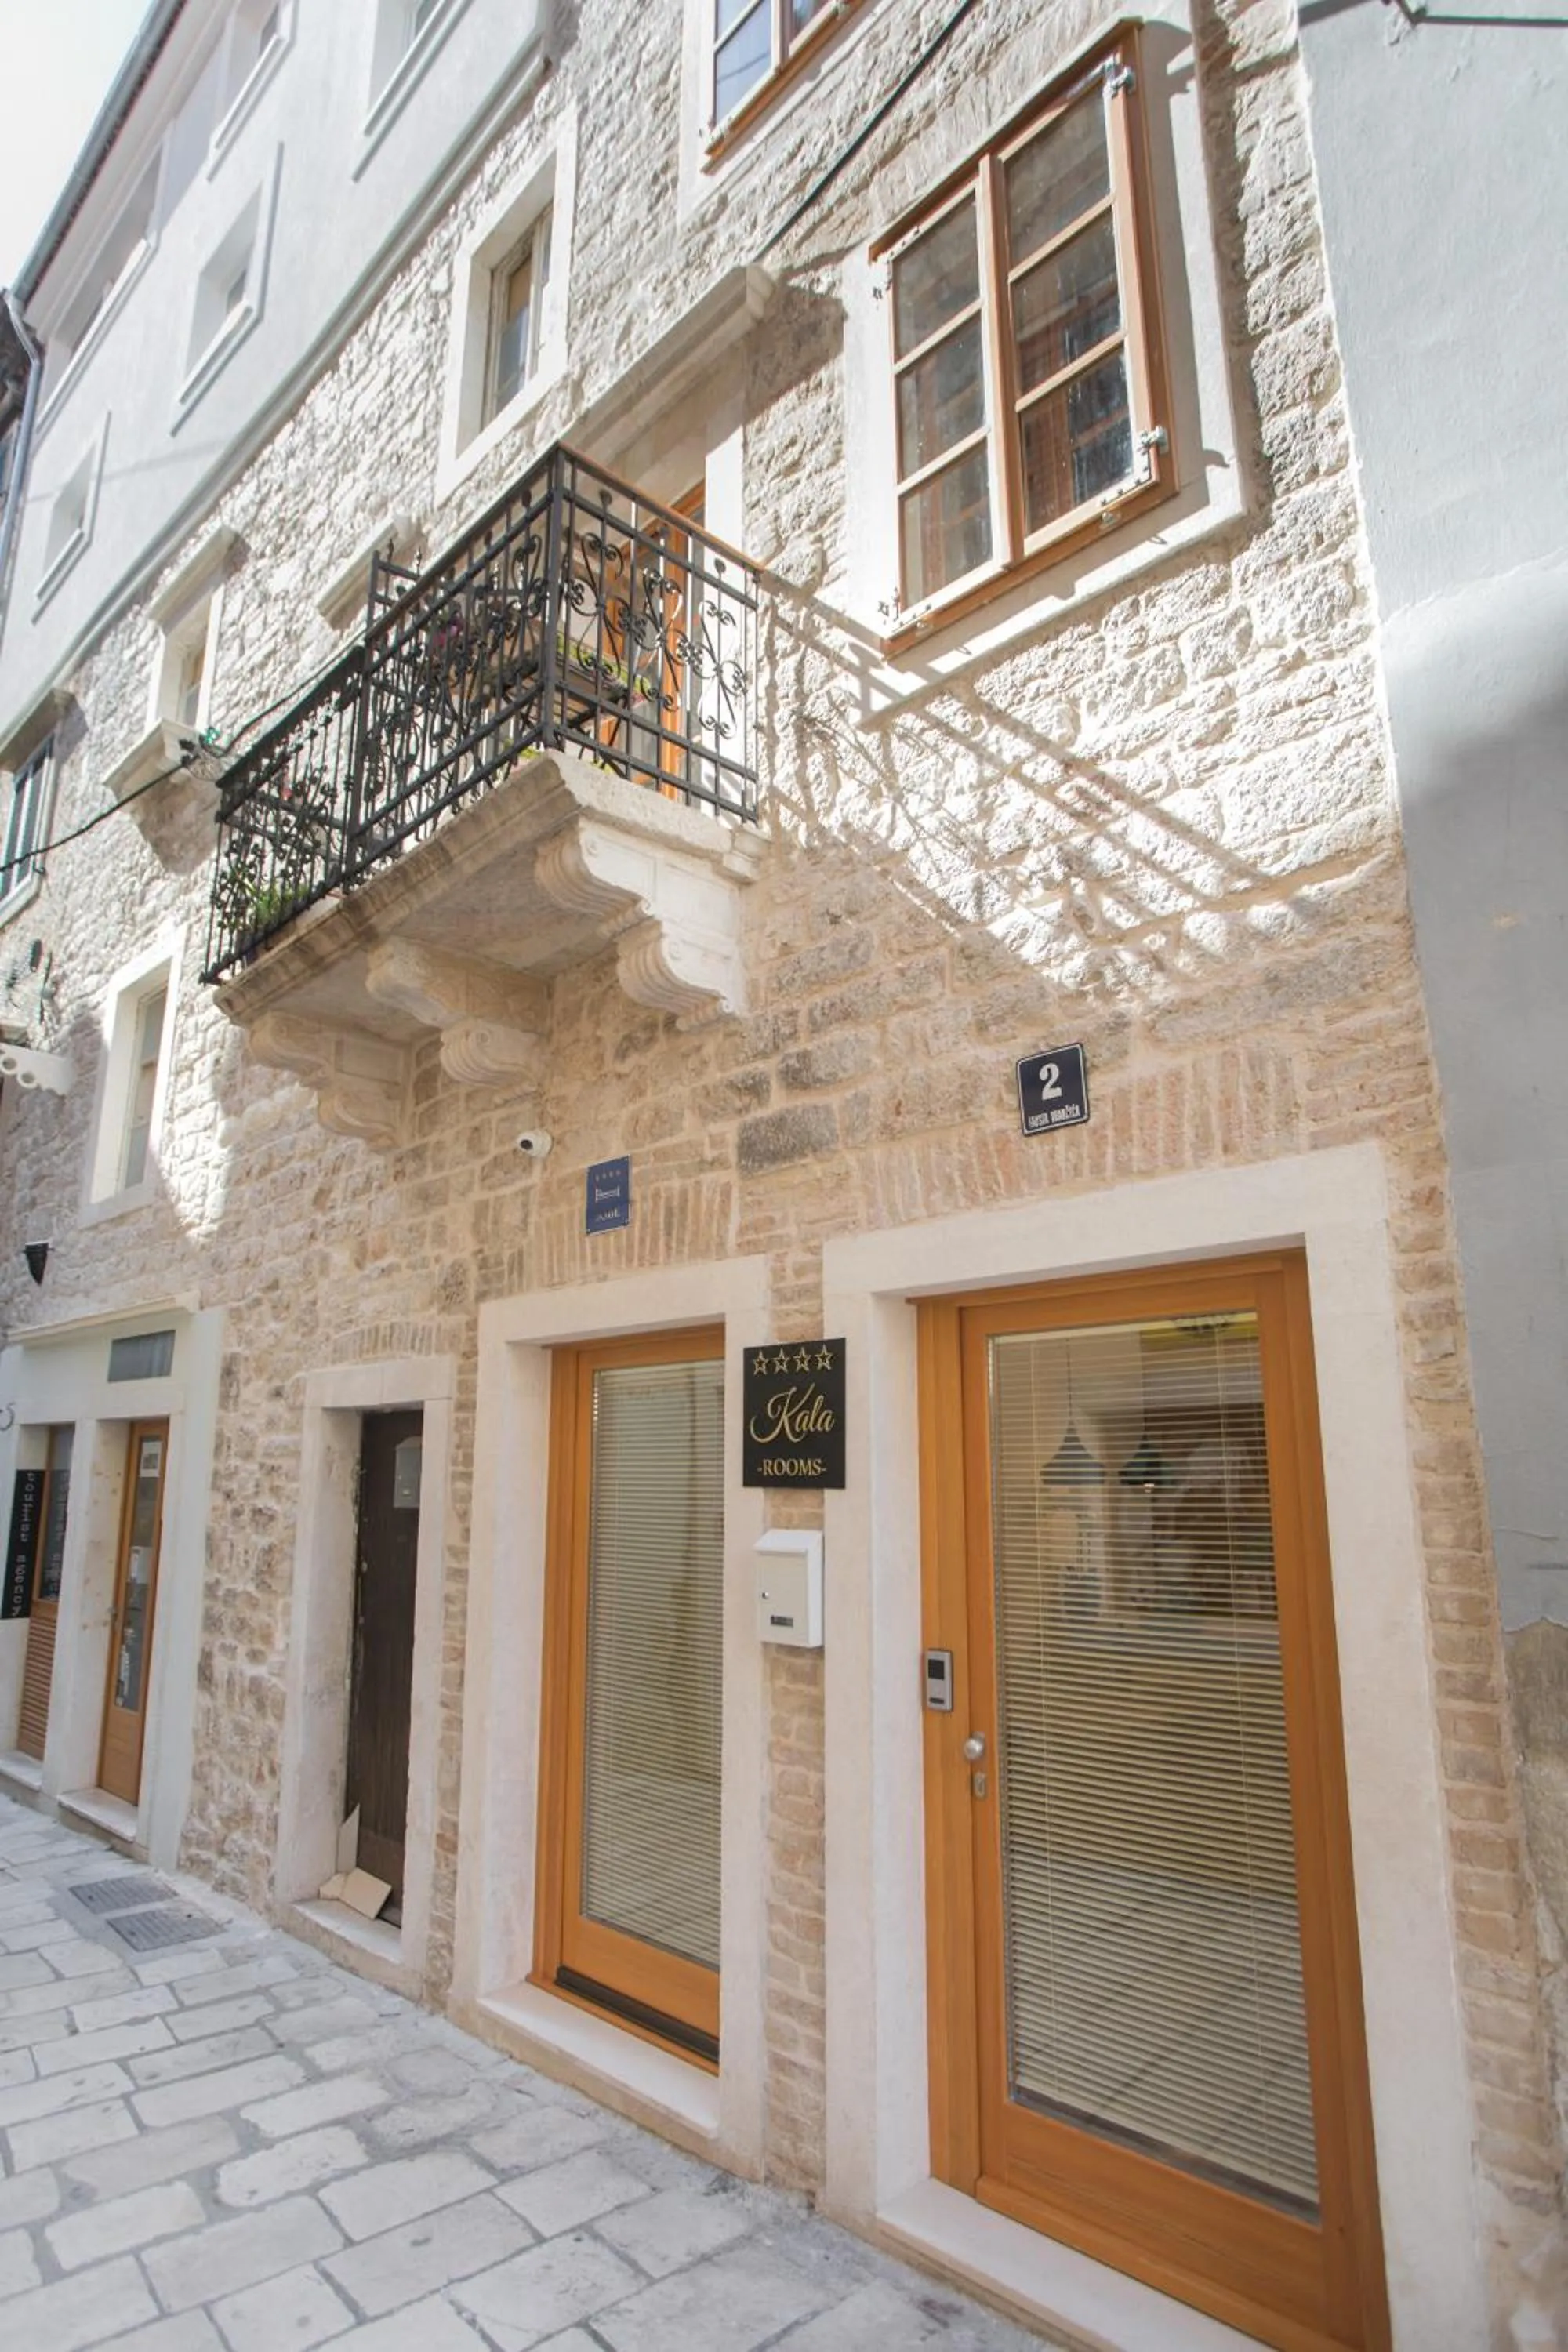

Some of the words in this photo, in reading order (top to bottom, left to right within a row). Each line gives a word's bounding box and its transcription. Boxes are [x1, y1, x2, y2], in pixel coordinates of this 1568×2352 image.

[1039, 1062, 1063, 1101] 2
[750, 1382, 835, 1443] Kala
[11, 1555, 27, 1617] agency
